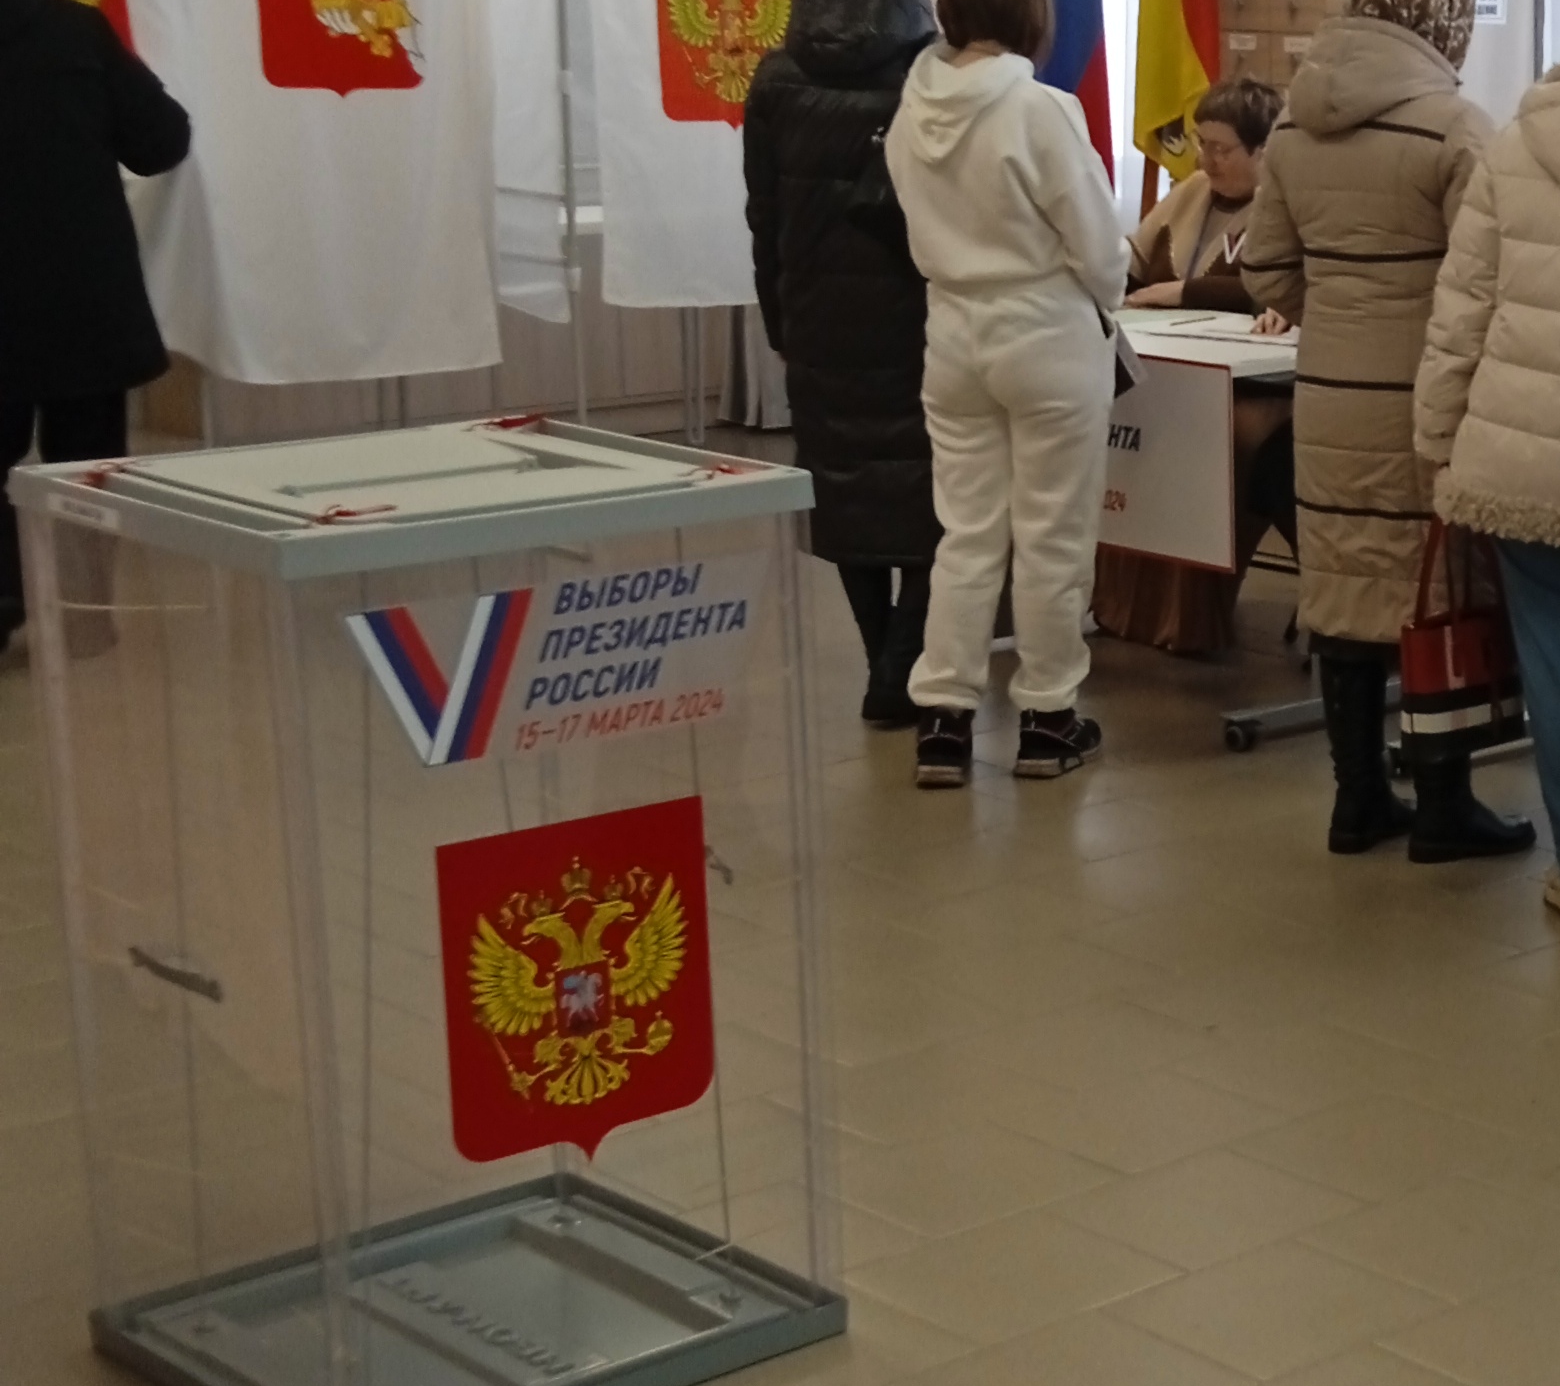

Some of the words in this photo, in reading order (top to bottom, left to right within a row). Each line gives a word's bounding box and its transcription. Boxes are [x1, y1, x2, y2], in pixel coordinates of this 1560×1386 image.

[554, 563, 703, 615] ВЫБОРЫ
[540, 600, 747, 663] ПРЕЗИДЕНТА
[525, 657, 662, 710] РОССИИ
[587, 699, 664, 737] МАРТА
[669, 688, 724, 722] 2024
